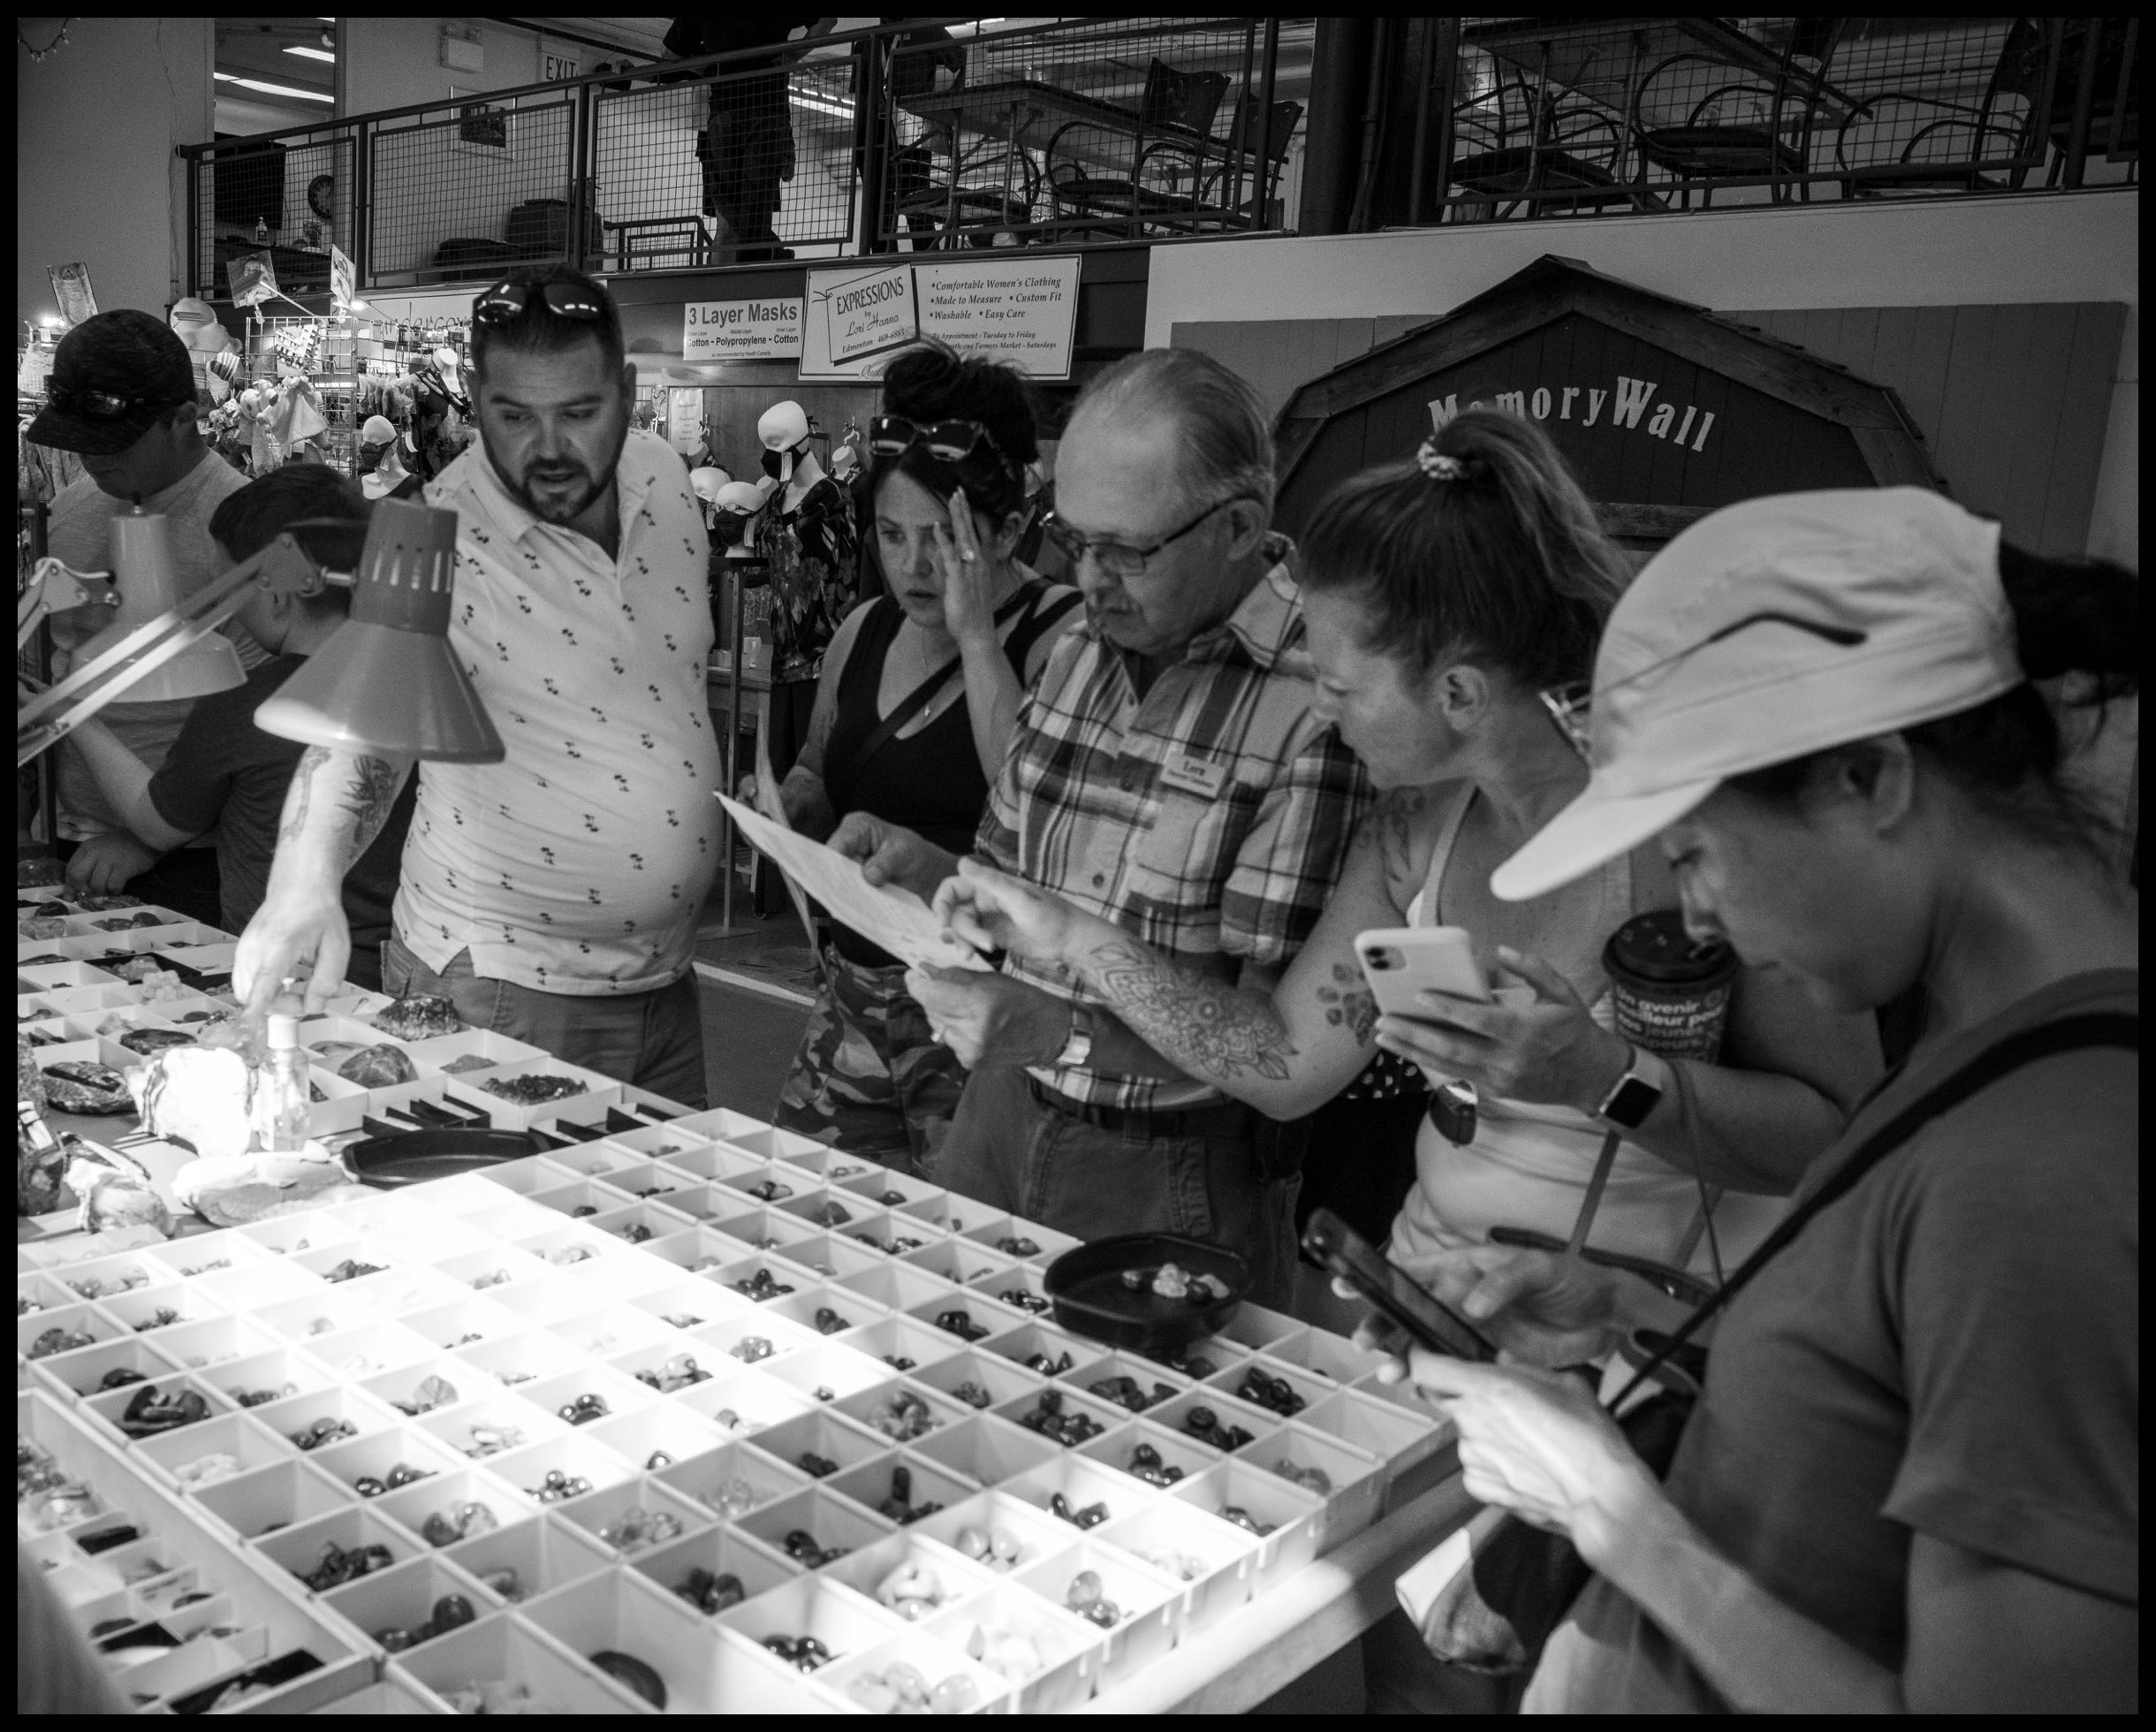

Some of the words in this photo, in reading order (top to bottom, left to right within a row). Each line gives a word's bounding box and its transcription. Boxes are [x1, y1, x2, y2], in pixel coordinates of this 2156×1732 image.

[546, 56, 576, 81] EXIT
[936, 279, 984, 292] Comfortable
[986, 277, 1022, 289] Women's
[1025, 277, 1061, 289] Clothing
[837, 277, 904, 315] EXPRESSIONS
[935, 296, 956, 305] Made
[968, 294, 1002, 304] Measure
[1015, 292, 1047, 302] Custom
[1049, 292, 1062, 301] Fit
[689, 307, 697, 325] 3
[702, 307, 744, 329] Layer
[748, 301, 798, 323] Masks
[934, 310, 972, 320] Washable
[984, 309, 1005, 321] Easy
[1006, 308, 1026, 318] Care
[846, 321, 865, 338] Lori
[867, 312, 899, 330] Hanna
[716, 336, 766, 346] Polypropylene
[774, 335, 799, 344] Cotton
[941, 332, 978, 341] Appointment
[1016, 330, 1036, 339] Friday
[842, 339, 873, 353] Edmonton
[1026, 341, 1057, 350] Saturdays
[1639, 999, 1702, 1014] avenir
